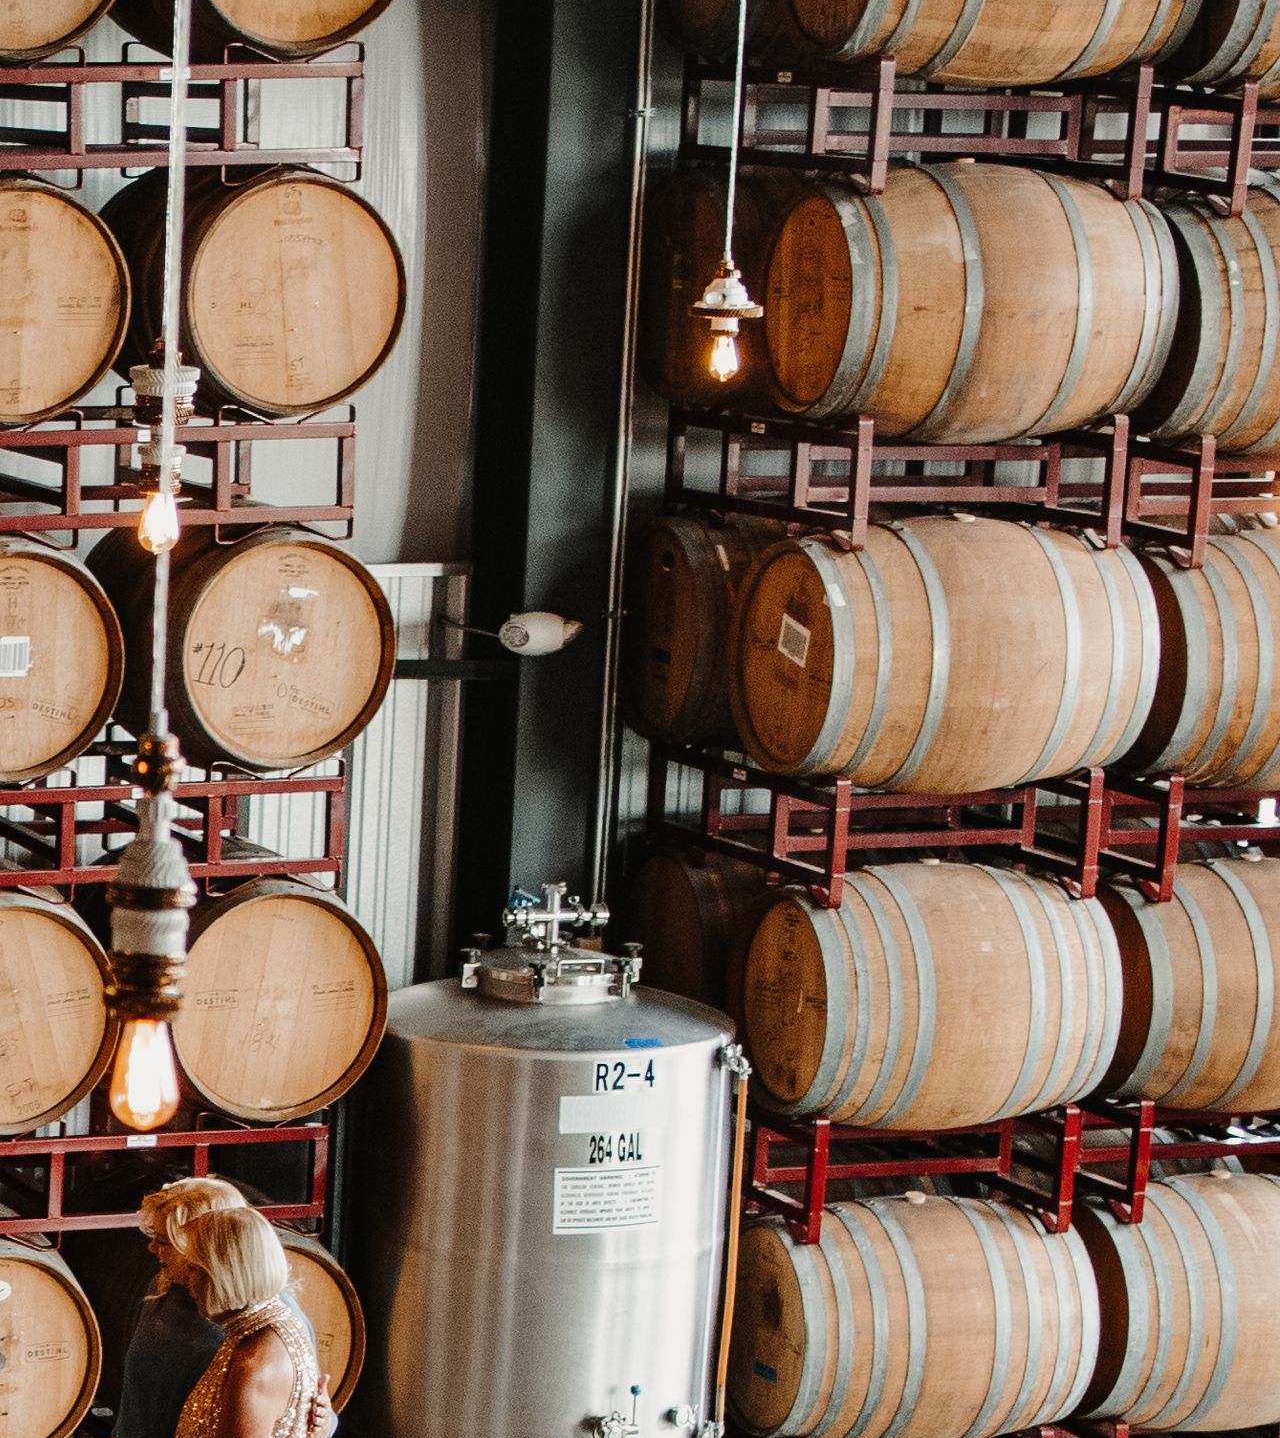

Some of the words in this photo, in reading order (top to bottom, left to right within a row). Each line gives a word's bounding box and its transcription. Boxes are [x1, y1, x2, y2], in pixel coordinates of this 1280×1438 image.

[291, 693, 333, 716] DESTIHL
[195, 994, 237, 1006] DESTIHL
[596, 1059, 656, 1092] R2-4
[589, 1134, 613, 1164] 264
[617, 1132, 643, 1163] GAL
[27, 1345, 69, 1359] DESTIHL
